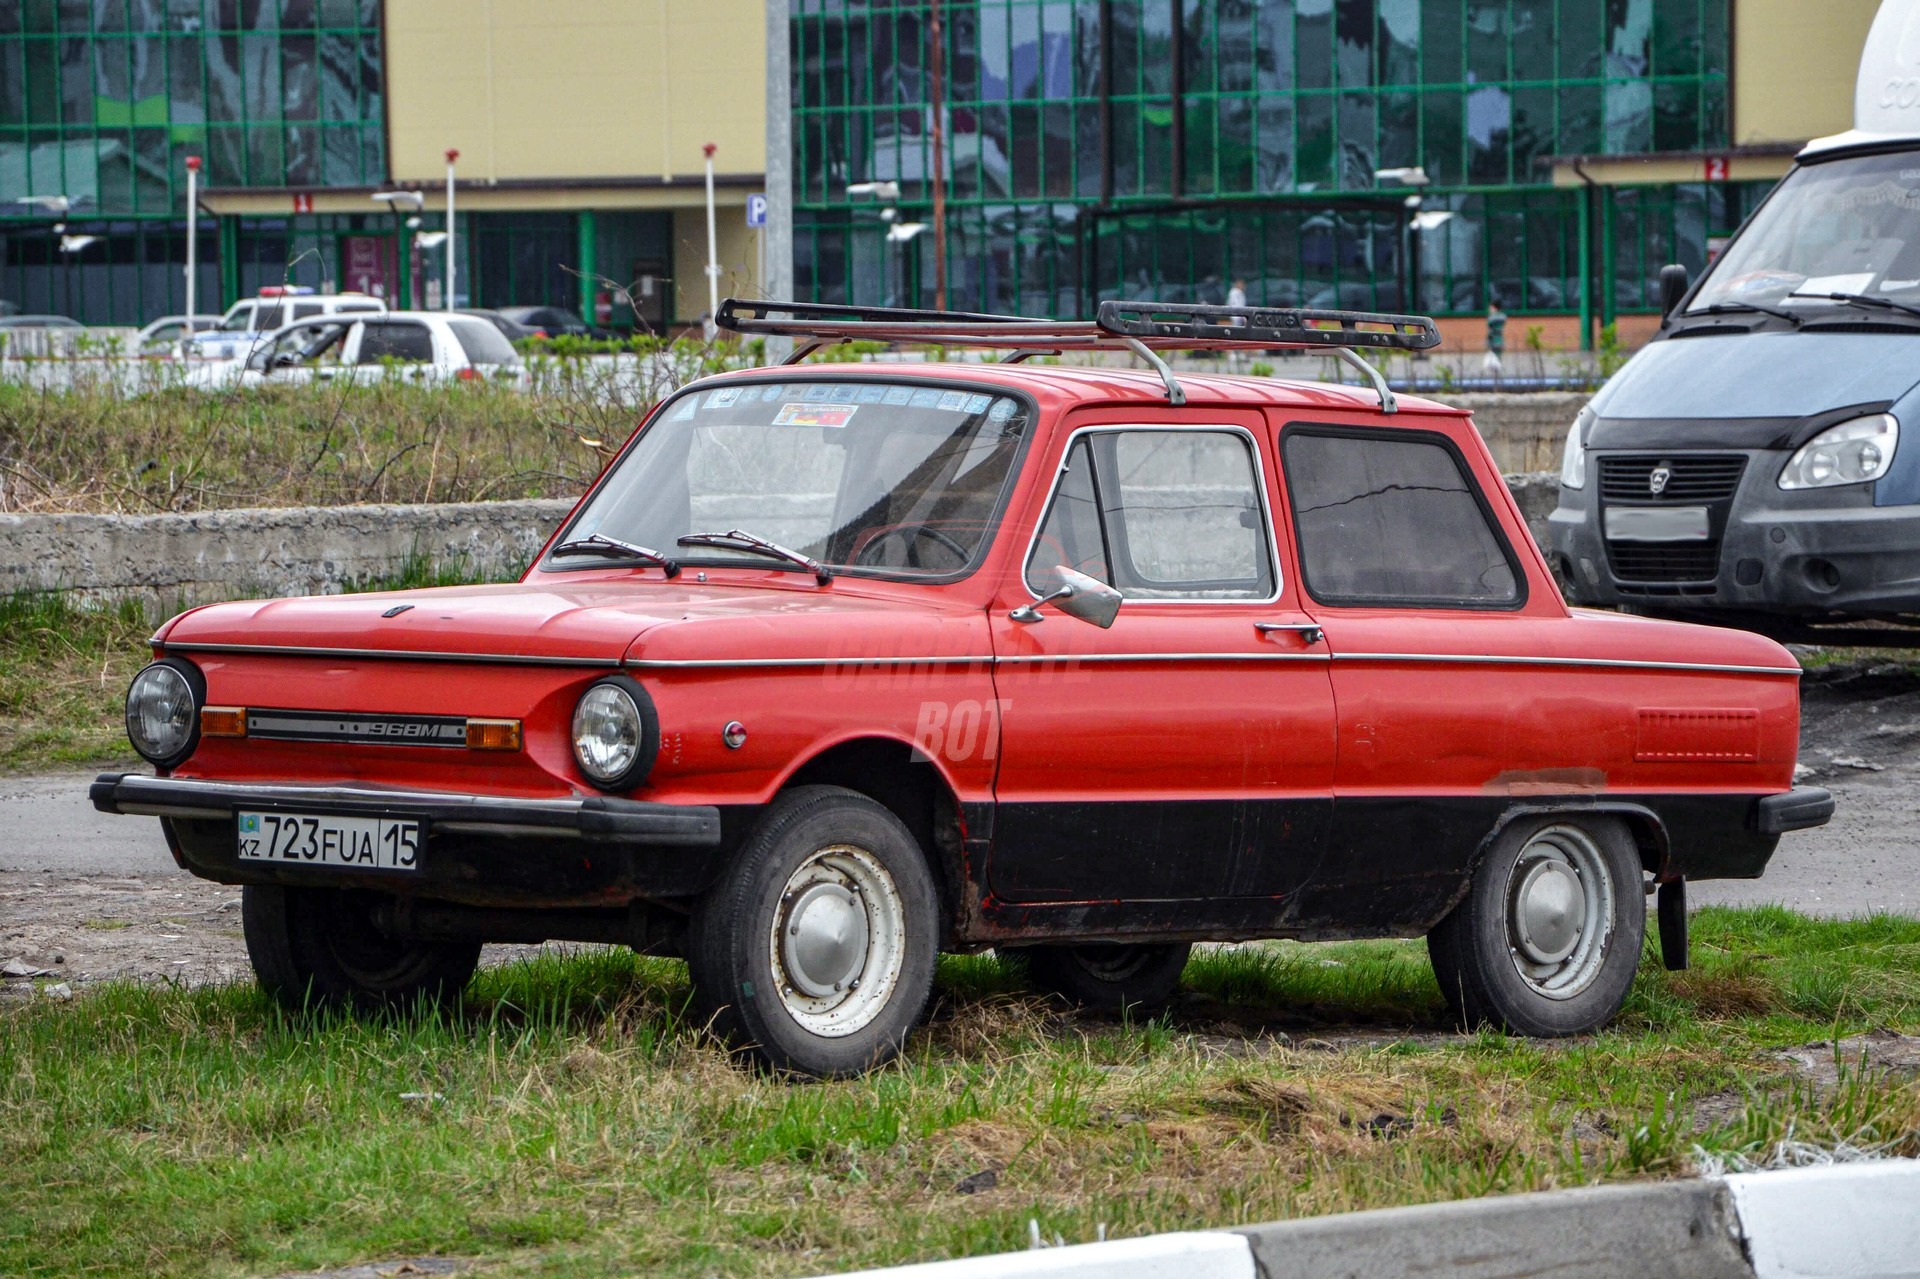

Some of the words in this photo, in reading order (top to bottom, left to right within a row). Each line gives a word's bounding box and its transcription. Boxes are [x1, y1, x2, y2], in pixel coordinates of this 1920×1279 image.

[1709, 159, 1724, 180] 2
[752, 197, 767, 222] P
[368, 721, 441, 738] 968M
[238, 838, 260, 857] KZ
